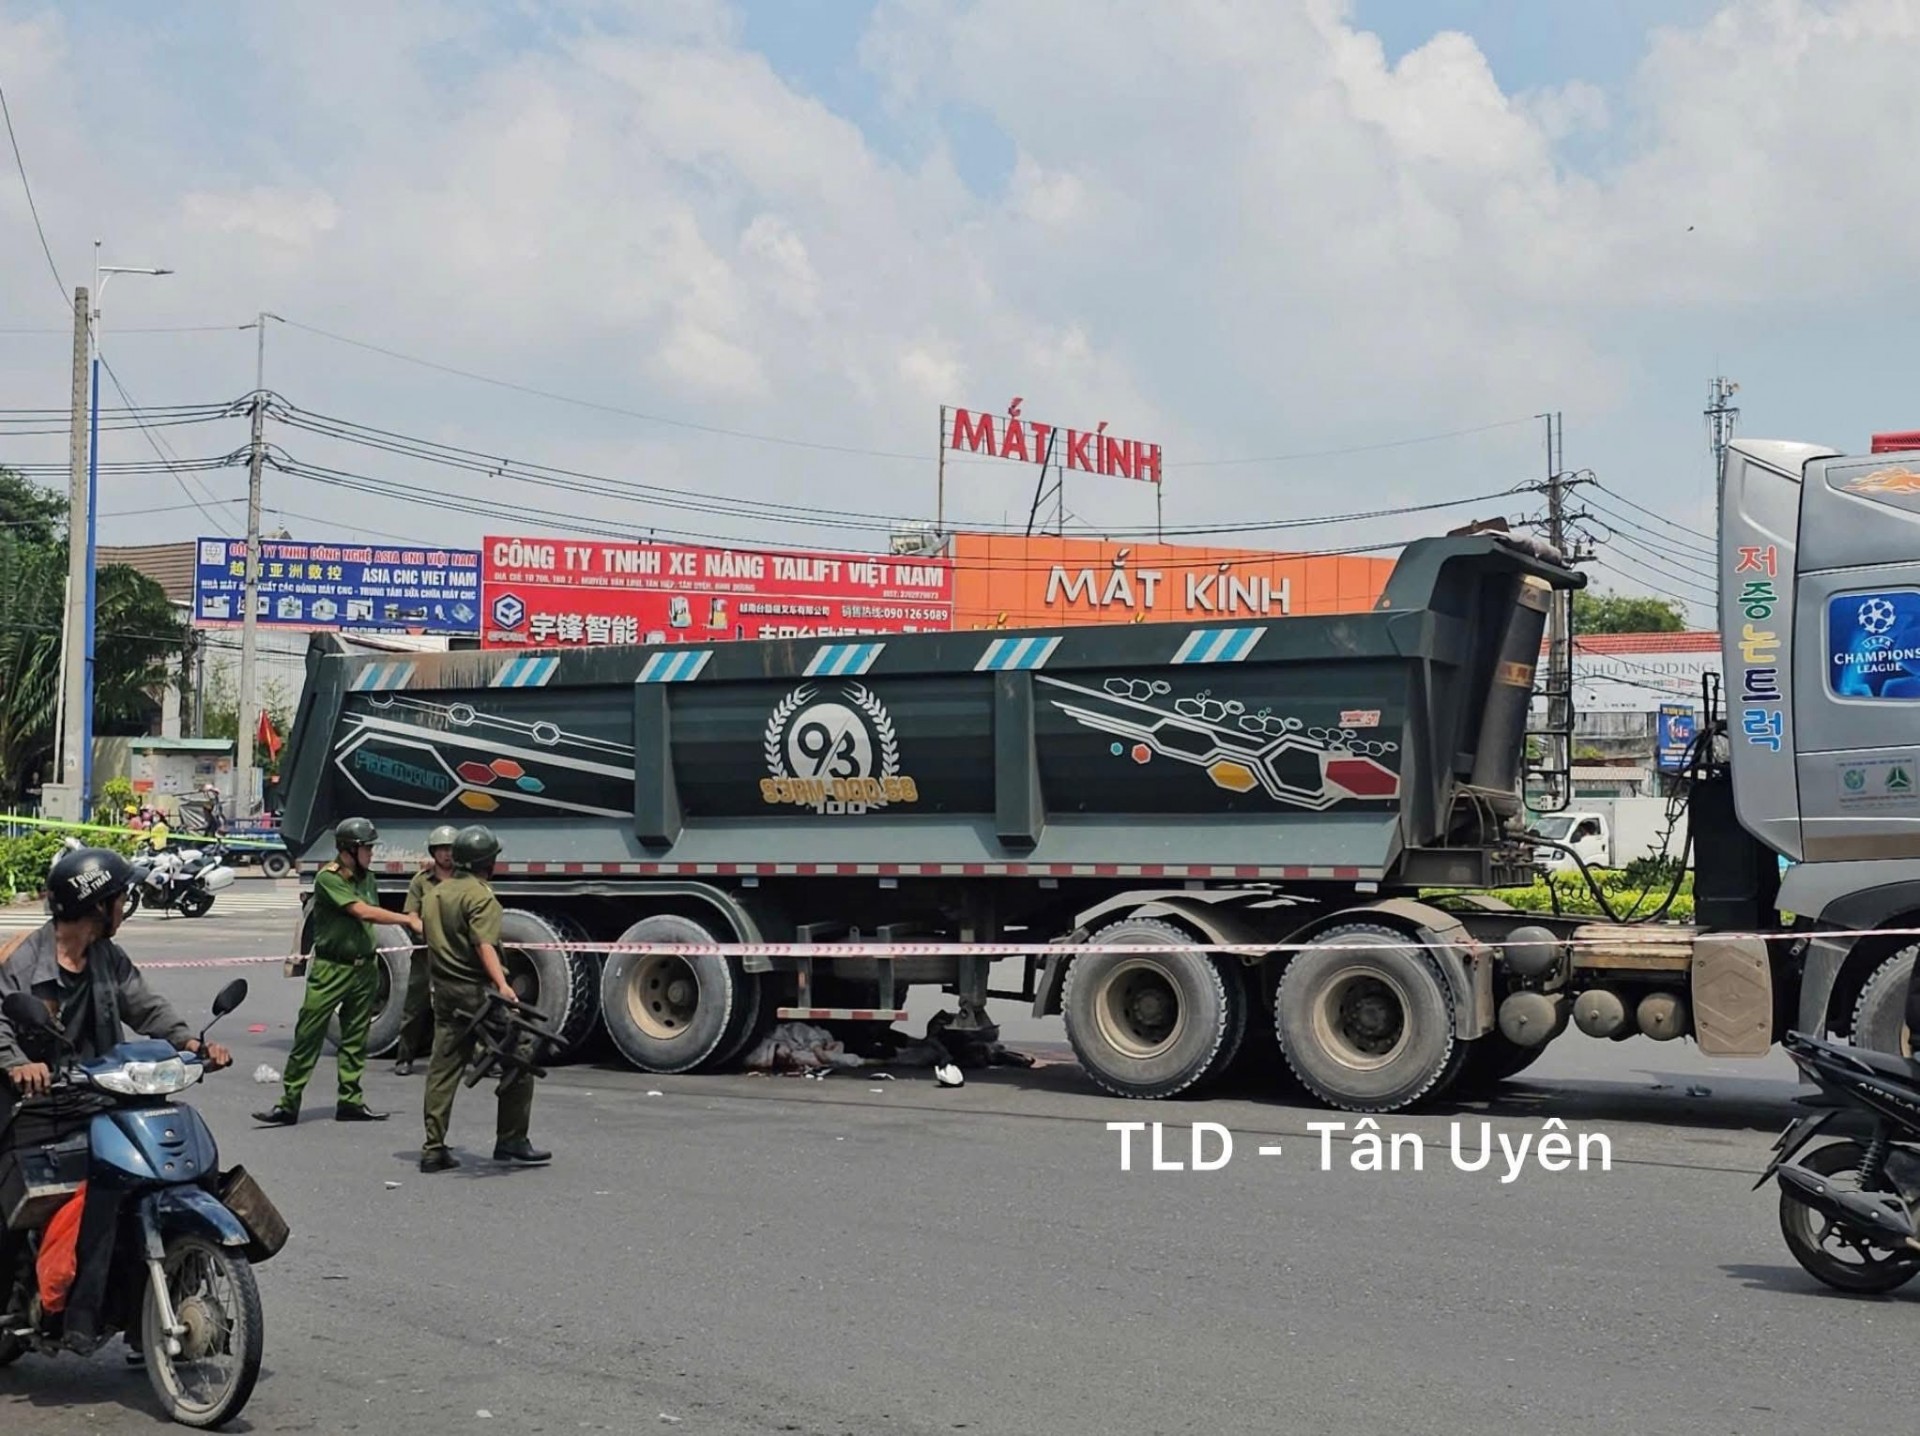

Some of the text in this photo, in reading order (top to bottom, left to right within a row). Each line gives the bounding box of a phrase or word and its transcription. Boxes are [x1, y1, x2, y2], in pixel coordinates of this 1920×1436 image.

[952, 397, 1161, 483] MẮT KÍNH
[262, 544, 277, 559] TY
[278, 545, 308, 560] TNHH
[310, 544, 341, 562] CÔNG
[342, 547, 373, 565] NGHỆ
[374, 550, 401, 565] ASIA
[402, 551, 425, 566] CNC
[427, 551, 449, 568] VIỆT
[451, 553, 478, 568] NAM
[494, 539, 944, 588] CÔNG TY TNHH XE NÂNG TAILIFT VIỆT NAM
[362, 567, 477, 587] ASIA CNC VIET NAM
[1046, 548, 1291, 615] MẮT KÍNH
[337, 586, 353, 595] CNC
[460, 590, 476, 600] CNC
[530, 612, 638, 644] 宇锋智能
[1863, 637, 1892, 649] UEFA
[1856, 661, 1903, 674] LEAGUE
